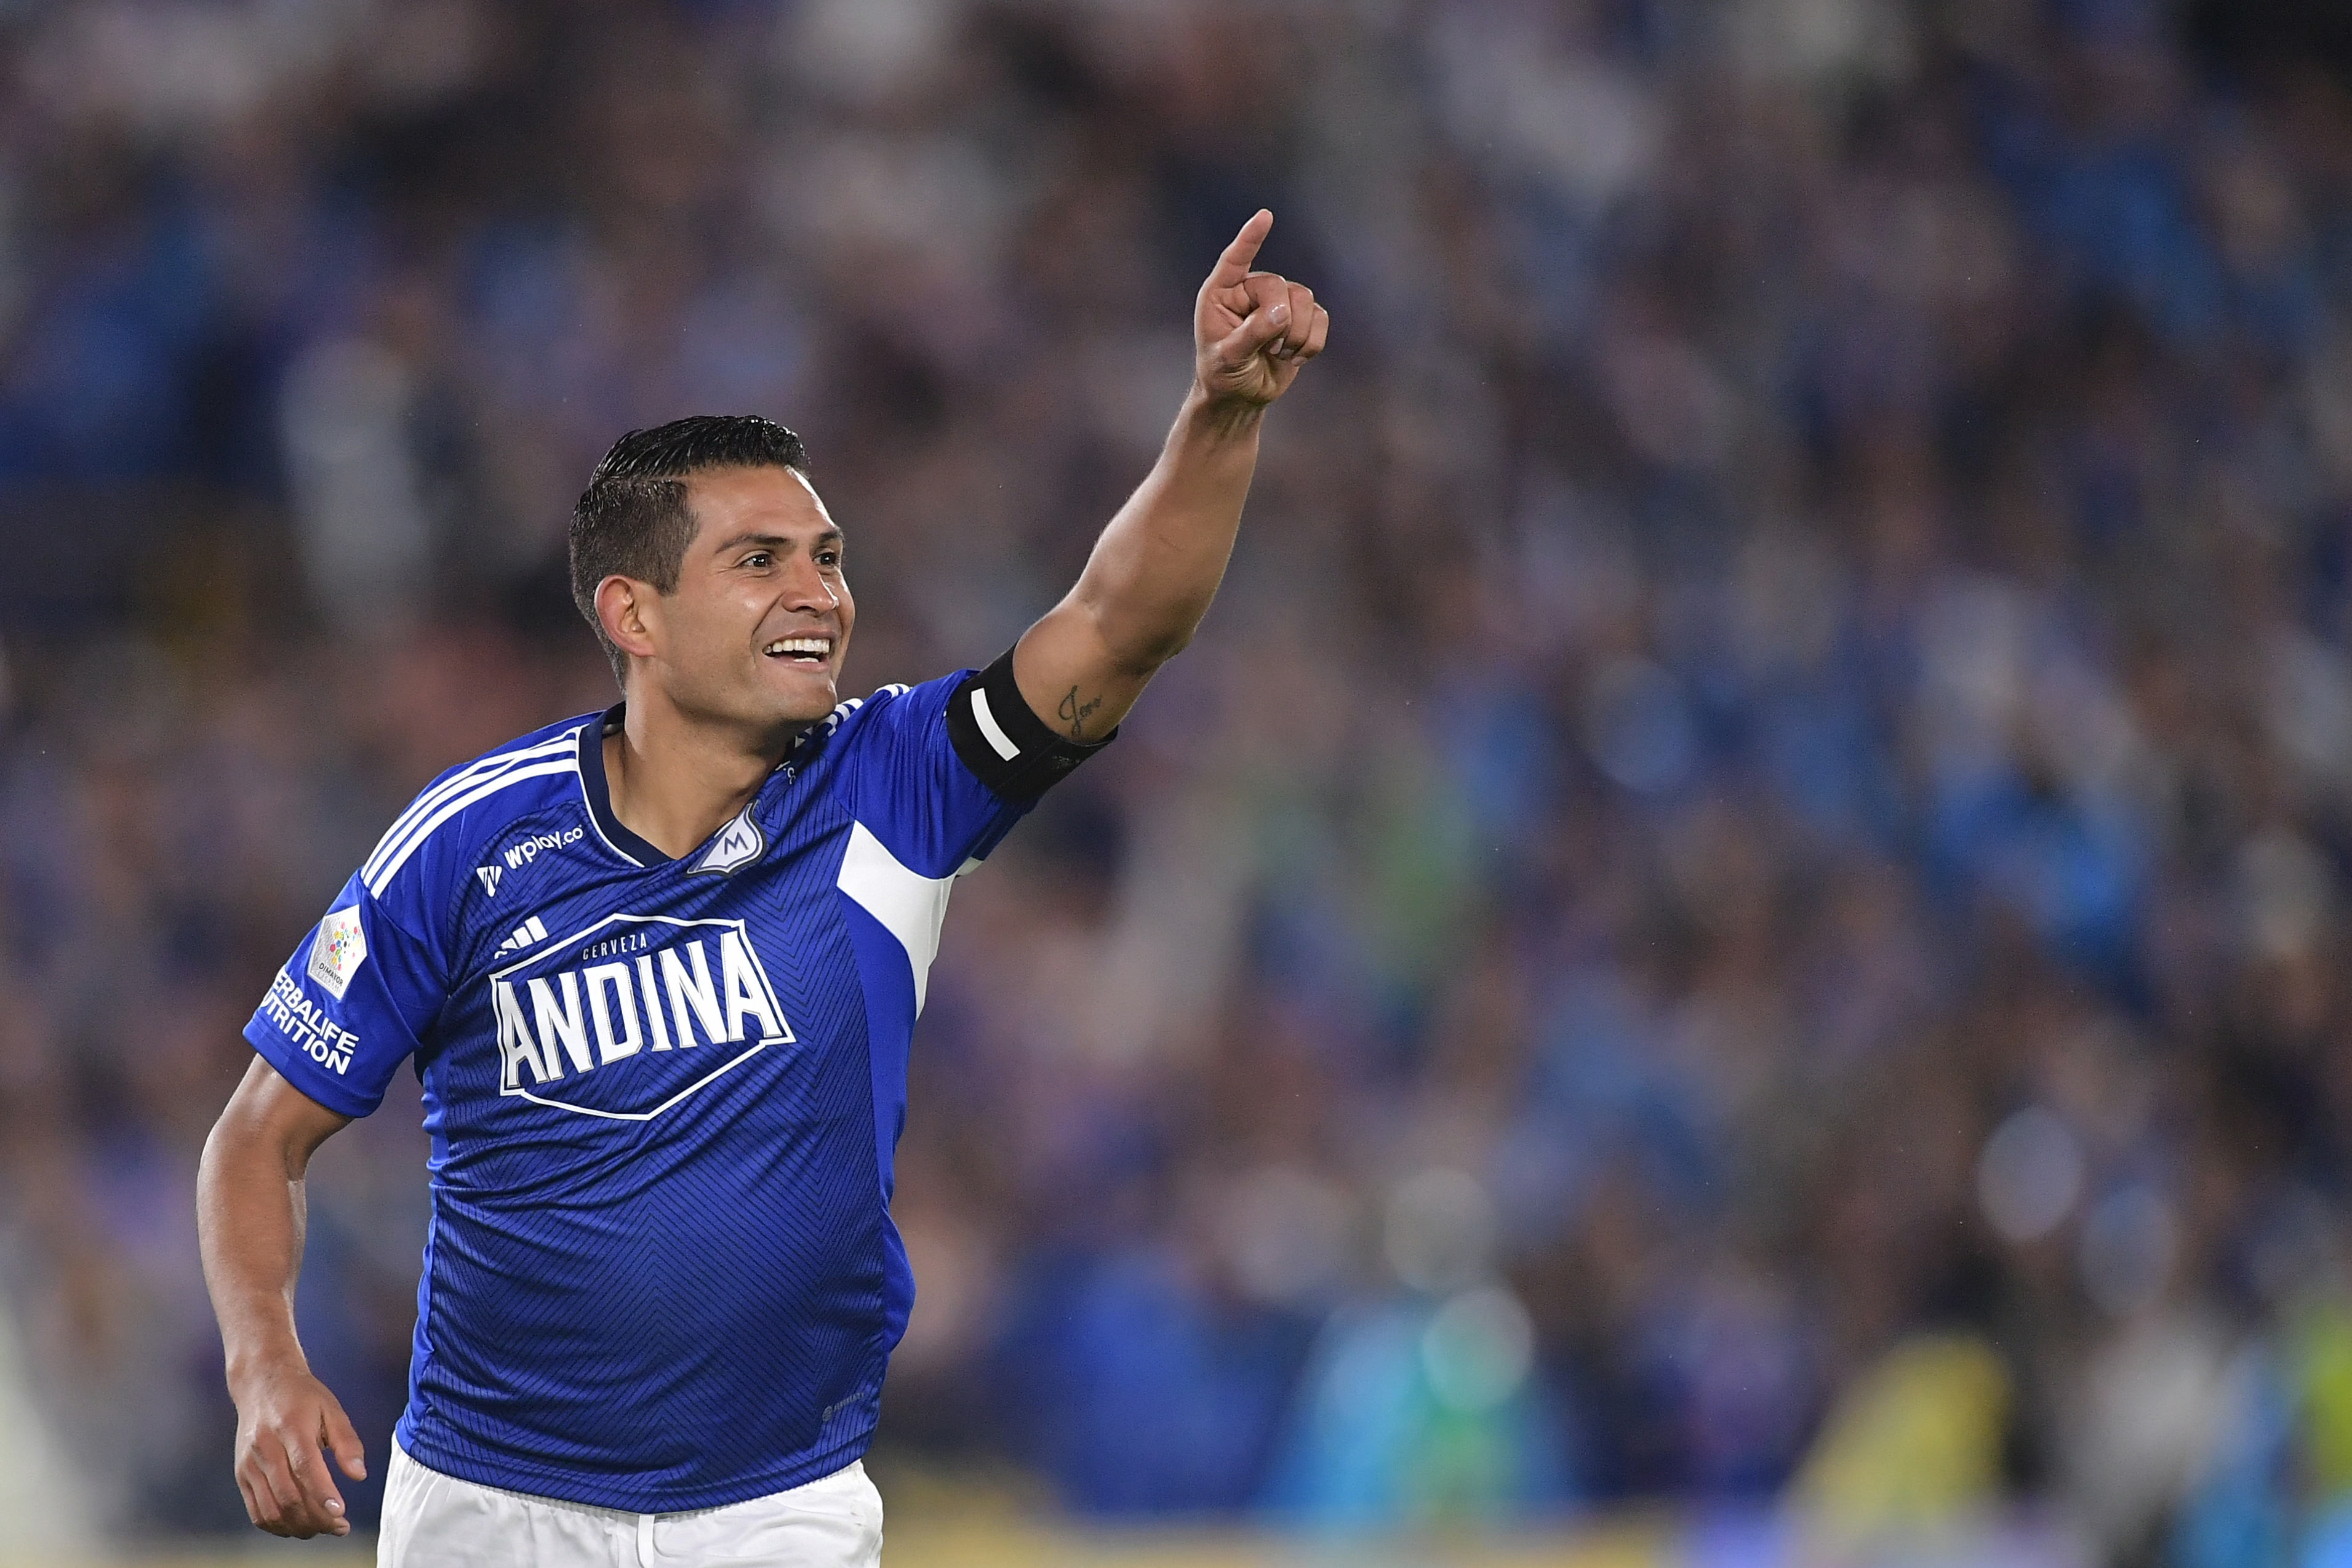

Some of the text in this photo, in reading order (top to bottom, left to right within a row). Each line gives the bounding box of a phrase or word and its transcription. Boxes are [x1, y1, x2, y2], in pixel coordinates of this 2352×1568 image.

[724, 832, 750, 855] M
[583, 932, 647, 961] CERVEZA
[319, 962, 343, 986] DIMAYOR
[497, 930, 783, 1087] ANDINA
